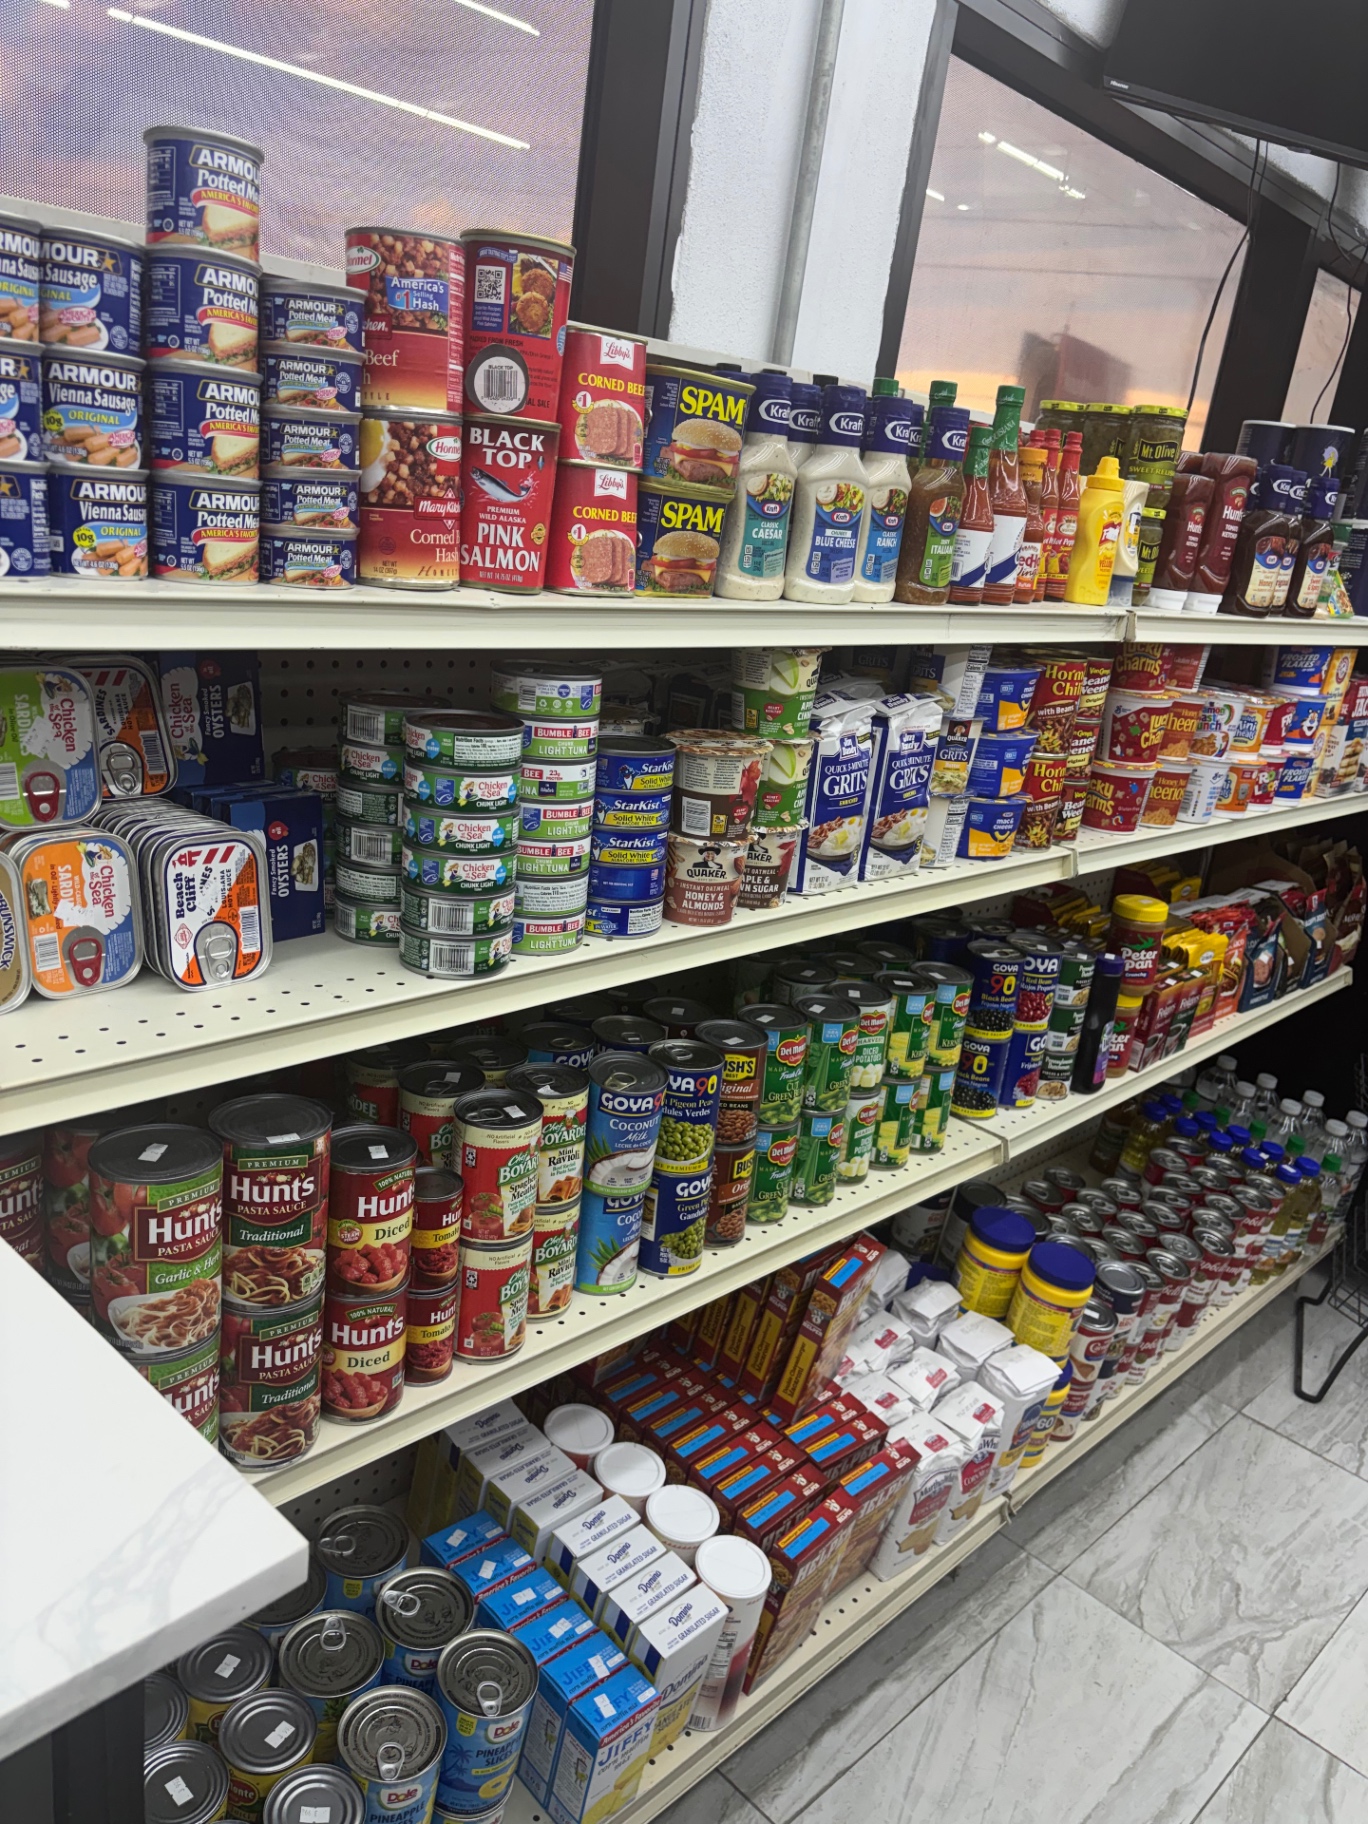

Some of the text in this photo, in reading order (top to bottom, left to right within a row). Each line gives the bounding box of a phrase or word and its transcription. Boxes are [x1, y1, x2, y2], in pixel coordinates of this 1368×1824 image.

[197, 169, 245, 196] Potted
[45, 264, 98, 293] Sausage
[391, 277, 444, 294] America's
[203, 288, 249, 312] Potted
[288, 300, 336, 313] ARMOUR
[413, 300, 439, 311] Hash
[289, 310, 337, 323] Potted Meat
[605, 341, 631, 360] Libby's
[279, 360, 327, 374] ARMOUR
[49, 362, 137, 391] ARMOUR
[279, 371, 326, 384] Potted Meat
[49, 382, 93, 406] Vienna
[94, 390, 136, 416] Sausage
[679, 386, 746, 426] SPAM
[68, 409, 120, 425] ORIGINAL
[205, 403, 248, 424] Potted
[283, 424, 330, 437] ARMOUR
[284, 434, 330, 446] Potted Meat
[469, 427, 545, 452] BLACK
[482, 449, 532, 469] TOP
[1155, 445, 1176, 457] Olive
[296, 485, 341, 495] ARMOUR
[598, 474, 625, 492] Libby's
[80, 502, 122, 521] Vienna
[419, 500, 445, 516] Mary
[486, 506, 520, 515] PREMIUM
[661, 500, 725, 533] SPAM
[197, 511, 242, 528] Potted
[479, 512, 526, 524] WILD ALASKA
[101, 526, 141, 537] ORIGINAL
[410, 529, 454, 545] Corned
[477, 523, 524, 547] PINK
[752, 528, 783, 540] CAESAR
[287, 543, 332, 553] ARMOUR
[815, 536, 856, 549] BLUE CHEESE
[436, 548, 459, 562] Hash
[460, 545, 540, 572] SALMON
[1280, 653, 1319, 661] FROSTED
[1282, 660, 1315, 668] FLAKES
[1115, 658, 1163, 676] Charms
[169, 683, 184, 738] Chicken
[183, 698, 195, 723] Sea
[210, 685, 224, 738] OYSTERS
[1037, 706, 1075, 717] with Beans
[60, 698, 77, 752] Chicken
[537, 729, 590, 737] BUMBLE BEE
[351, 750, 380, 763] Chicken
[539, 745, 588, 755] LIGHT TUNA
[939, 750, 969, 761] GRITS
[524, 769, 540, 778] BEE
[478, 782, 508, 792] Chicken
[823, 769, 868, 797] GRITS
[546, 807, 591, 818] BUMBLE BEE
[614, 800, 660, 811] StarKist
[613, 814, 655, 822] Solid White
[458, 824, 491, 833] Chicken
[608, 837, 655, 848] StarKist
[608, 851, 650, 859] Solid White
[278, 845, 290, 898] OYSTERS
[462, 864, 495, 873] Chicken
[687, 868, 727, 879] QUAKER
[100, 865, 115, 918] Chicken
[173, 872, 184, 919] Beach
[185, 876, 197, 912] Cliff
[685, 891, 724, 901] HONEY &
[753, 884, 779, 893] SUGAR
[682, 900, 724, 911] ALMONDS
[529, 921, 579, 933] BUMBLE BEE
[530, 936, 576, 949] LIGHT TUNA
[1121, 947, 1158, 961] Peter
[993, 963, 1019, 972] GOYA
[1123, 958, 1153, 971] Pan
[990, 975, 1016, 995] 90
[963, 1040, 990, 1052] GOYA
[961, 1053, 988, 1074] 90
[601, 1092, 653, 1112] GOYA
[768, 1092, 793, 1101] GREEN
[685, 1108, 710, 1117] Verdes
[610, 1115, 660, 1131] COCONUT
[620, 1131, 648, 1142] Milk
[508, 1150, 528, 1167] Chef
[548, 1150, 580, 1168] Ravioli
[558, 1148, 574, 1157] Mini
[772, 1148, 782, 1156] Del
[247, 1158, 300, 1169] PREMIUM
[168, 1184, 215, 1206] PREMIUM
[230, 1174, 317, 1203] Hunt's
[759, 1189, 780, 1200] GREEN
[237, 1201, 307, 1215] PASTA SAUCE
[678, 1203, 699, 1212] Green
[240, 1225, 305, 1241] Traditional
[374, 1217, 410, 1241] Diced
[157, 1226, 219, 1257] PASTA SAUCE
[154, 1263, 201, 1286] Garlic &
[269, 1316, 315, 1338] PREMIUM
[332, 1316, 404, 1346] Hunt's
[802, 1321, 823, 1337] HELPER
[251, 1327, 322, 1369] Hunt's
[259, 1354, 318, 1380] PASTA SAUCE
[347, 1351, 390, 1368] Diced
[169, 1356, 214, 1383] PREMIUM
[788, 1367, 803, 1398] Macaroni
[261, 1378, 316, 1405] Traditional
[552, 1489, 577, 1509] Domino
[802, 1483, 820, 1498] HELPER
[582, 1510, 606, 1531] Domino
[835, 1507, 853, 1523] HELPER
[590, 1513, 632, 1542] GRANULATED SUGAR
[607, 1541, 631, 1564] Domino
[615, 1546, 657, 1576] GRANULATED SUGAR
[637, 1570, 662, 1594] Domino
[647, 1573, 689, 1606] GRANULATED SUGAR
[668, 1602, 693, 1628] Domino
[677, 1607, 721, 1641] GRANULATED SUGAR
[661, 1653, 709, 1701] Domino
[493, 1719, 520, 1738] Dole
[601, 1700, 661, 1747] America's Favorite
[598, 1716, 656, 1767] JIFFY
[485, 1750, 513, 1766] SLICES
[387, 1787, 418, 1804] Dole
[369, 1801, 425, 1823] PINEAPPLE
